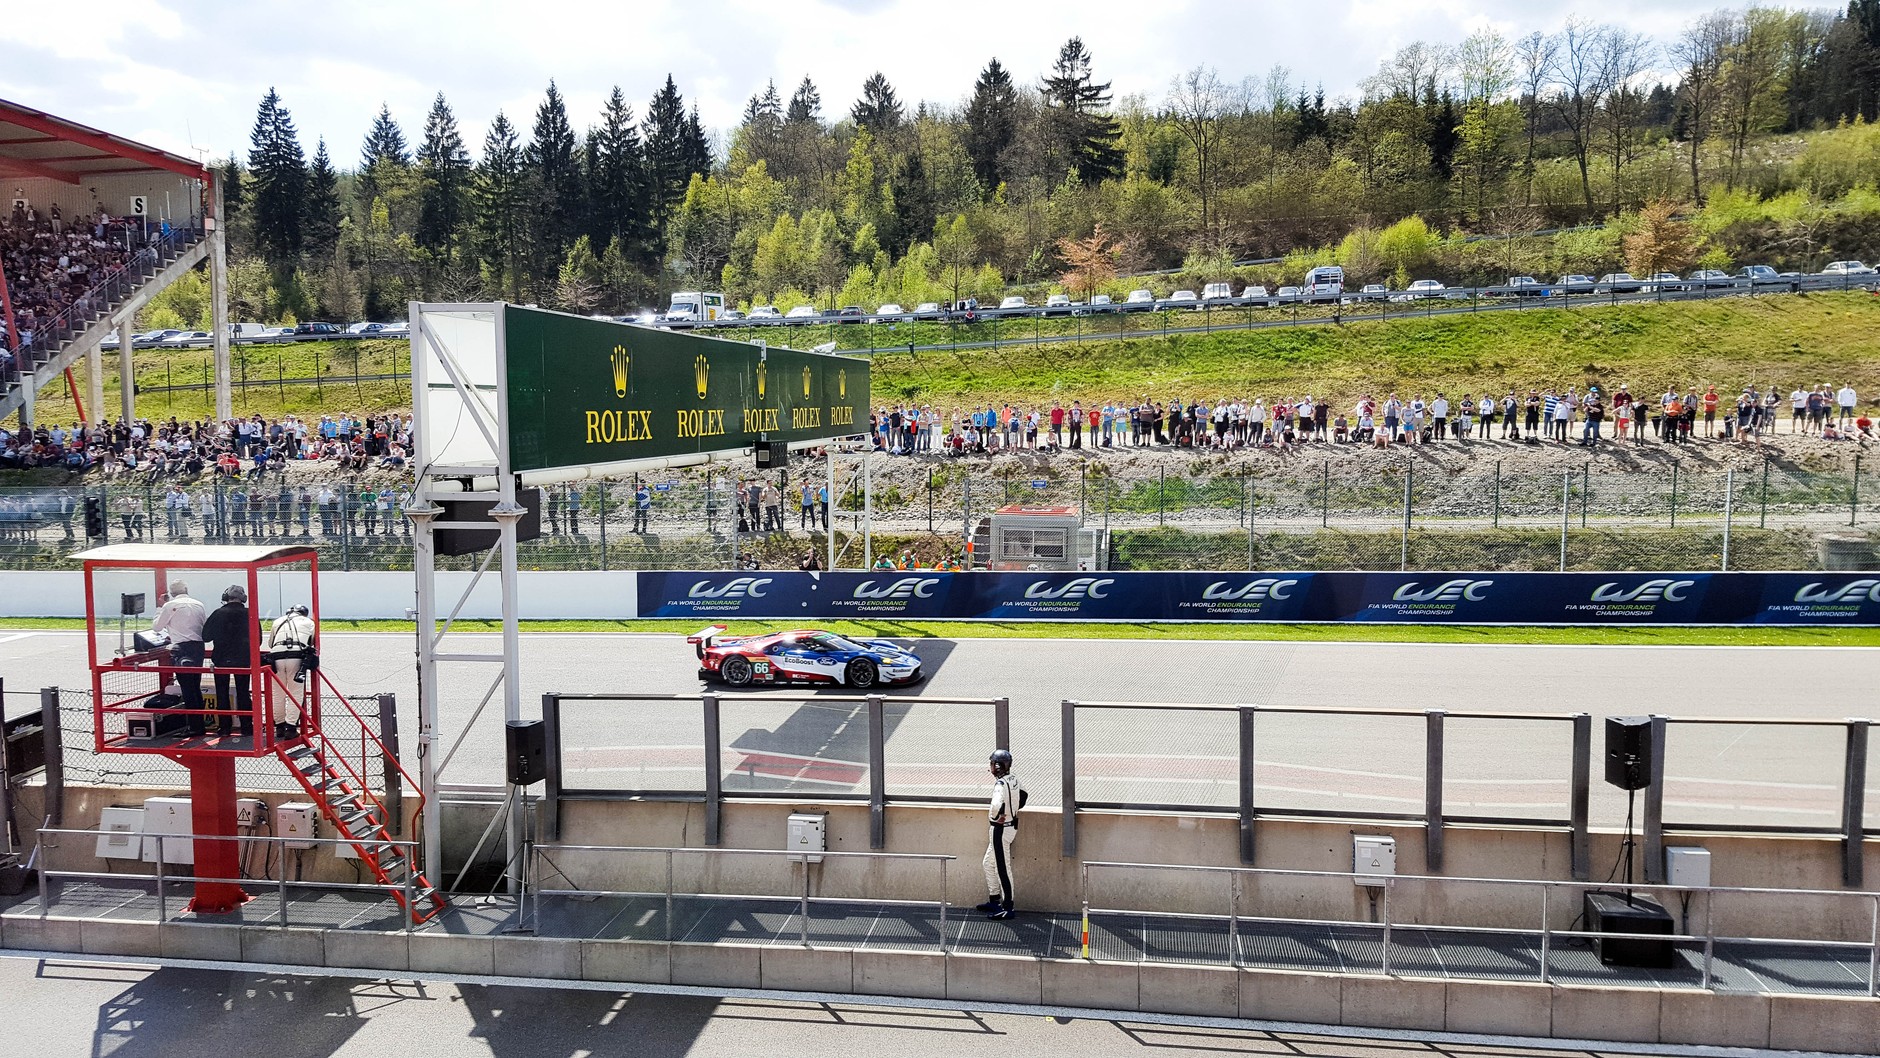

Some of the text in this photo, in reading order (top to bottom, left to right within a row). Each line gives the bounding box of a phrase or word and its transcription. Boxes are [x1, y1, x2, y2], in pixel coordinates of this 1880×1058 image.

[134, 198, 143, 213] S
[677, 409, 725, 438] ROLEX
[743, 408, 779, 433] ROLEX
[792, 407, 821, 429] ROLEX
[831, 406, 853, 426] ROLEX
[585, 410, 653, 443] ROLEX
[688, 578, 772, 597] WEC
[854, 578, 939, 598] WEC
[1025, 578, 1114, 598] WEC
[1203, 579, 1297, 599] WEC
[1393, 580, 1493, 601] WEC
[1591, 580, 1694, 601] WEC
[754, 663, 768, 674] 66
[820, 658, 834, 666] Ford
